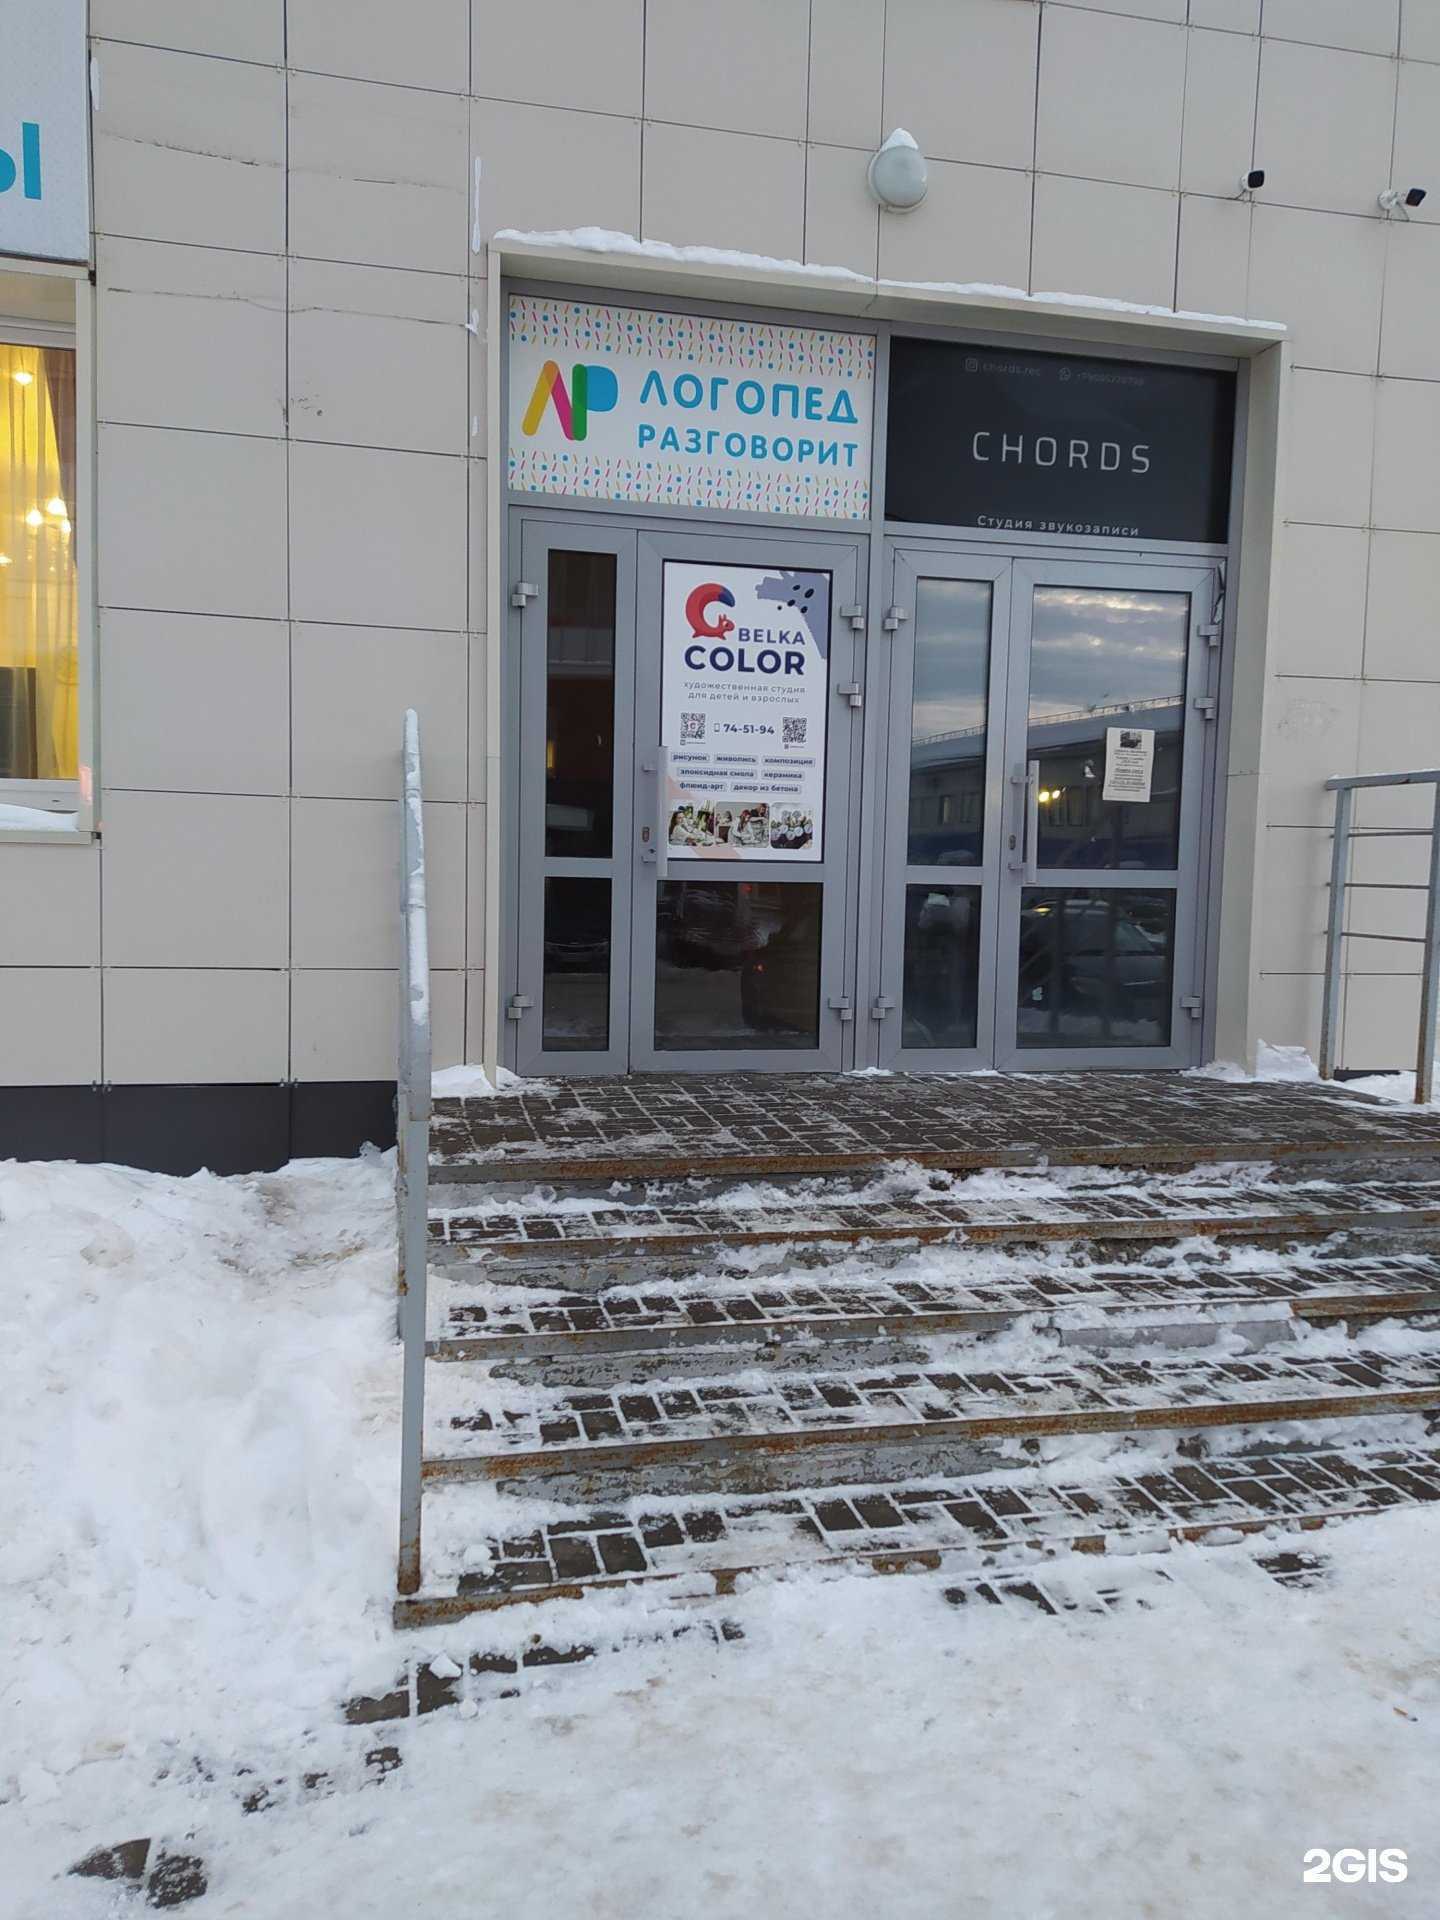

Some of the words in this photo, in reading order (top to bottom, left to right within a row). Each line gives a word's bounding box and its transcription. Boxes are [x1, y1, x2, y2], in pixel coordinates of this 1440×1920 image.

[639, 370, 858, 424] ЛОГОПЕД
[638, 424, 858, 467] РАЗГОВОРИТ
[973, 431, 1150, 473] CHORDS
[977, 514, 1033, 530] Студия
[1039, 520, 1139, 537] звукозаписи
[738, 628, 806, 645] BELKA
[684, 645, 806, 676] COLOR
[683, 681, 769, 693] художественная
[771, 686, 806, 695] студия
[688, 692, 707, 700] для
[709, 692, 740, 701] детей
[751, 695, 800, 704] взрослых
[723, 723, 775, 735] 74-51-94
[673, 753, 707, 763] рисунок
[716, 755, 757, 764] живопись
[764, 757, 813, 767] композиция
[680, 768, 728, 777] эпоксидная
[729, 770, 754, 778] смола
[764, 771, 803, 780] керамика
[679, 782, 724, 791] флюид-арт
[733, 784, 758, 793] декор
[771, 784, 799, 793] бетона
